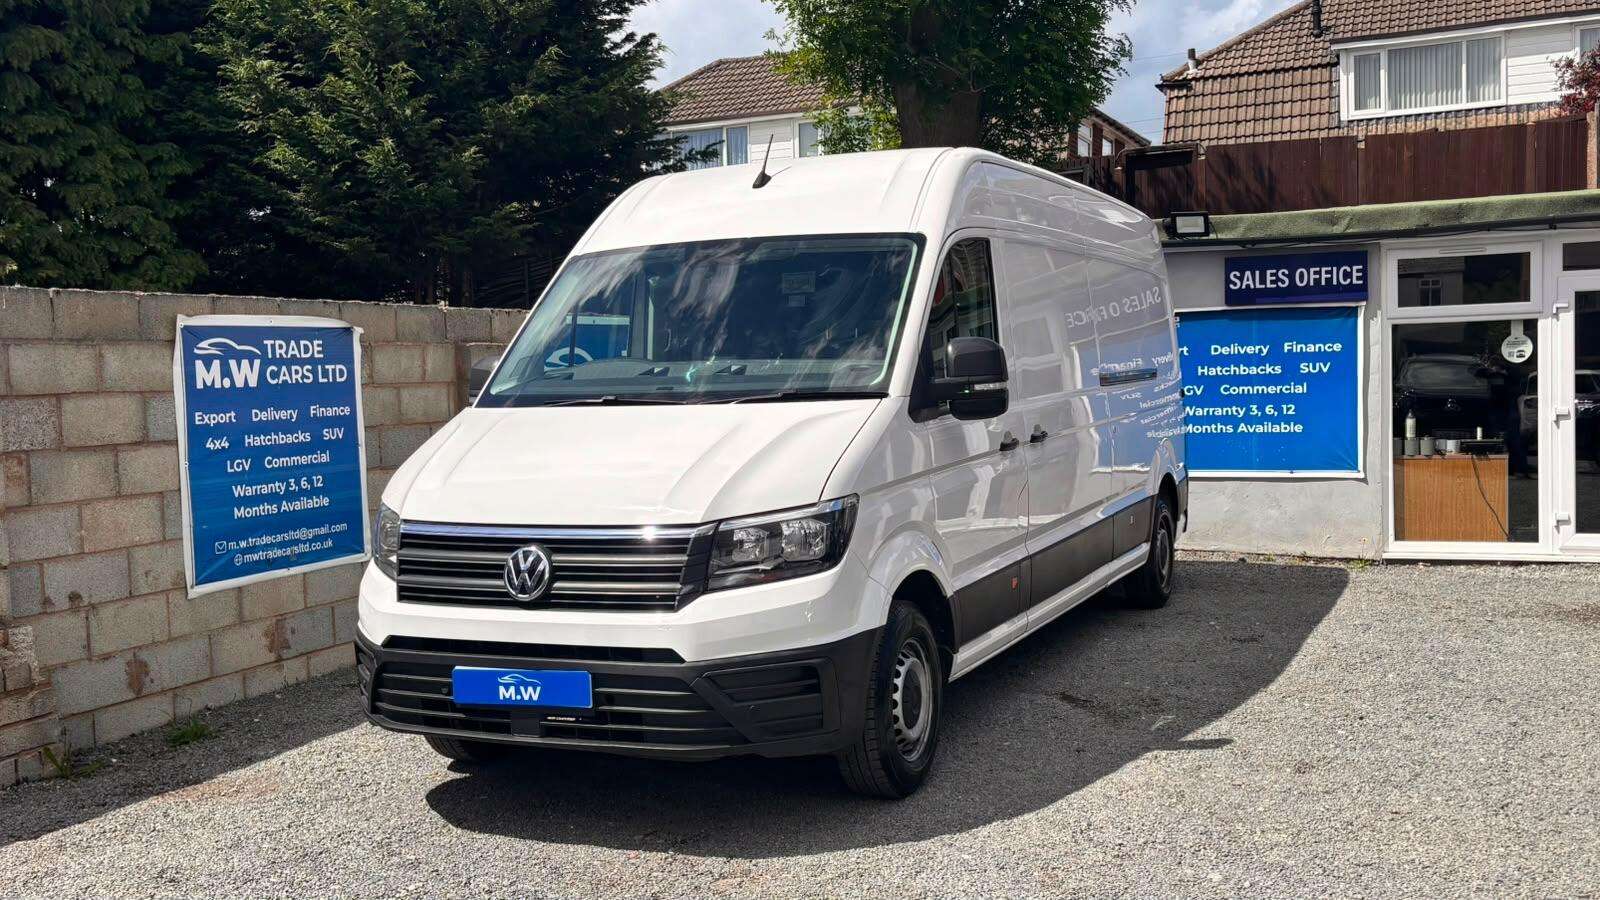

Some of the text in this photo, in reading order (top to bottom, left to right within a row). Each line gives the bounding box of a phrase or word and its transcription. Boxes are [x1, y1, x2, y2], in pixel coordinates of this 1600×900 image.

[1229, 265, 1363, 290] SALES OFFICE
[263, 340, 324, 359] TRADE
[1211, 341, 1342, 356] Delivery Finance
[195, 359, 261, 389] M.W
[266, 364, 348, 385] CARS LTD
[1197, 362, 1331, 376] Hatchbacks SUV
[1184, 382, 1307, 396] GV Commercial
[195, 404, 351, 427] Export Delivery Finance
[1185, 406, 1245, 418] Warranty
[1250, 405, 1261, 416] 3,
[1265, 405, 1277, 416] 6,
[1282, 404, 1296, 415] 12
[1185, 423, 1233, 433] Months
[1237, 422, 1303, 433] Available
[205, 428, 344, 450] 4x4 Hatchbacks SUV
[227, 450, 330, 473] LGV Commercial
[232, 476, 323, 498] Warranty 3, 6, 12
[234, 495, 329, 519] Months Available
[228, 522, 347, 550] m.w.tradecarsltd@gmail.com
[243, 538, 333, 563] mwtradecarsltd.co.uk
[499, 685, 541, 701] M.W
